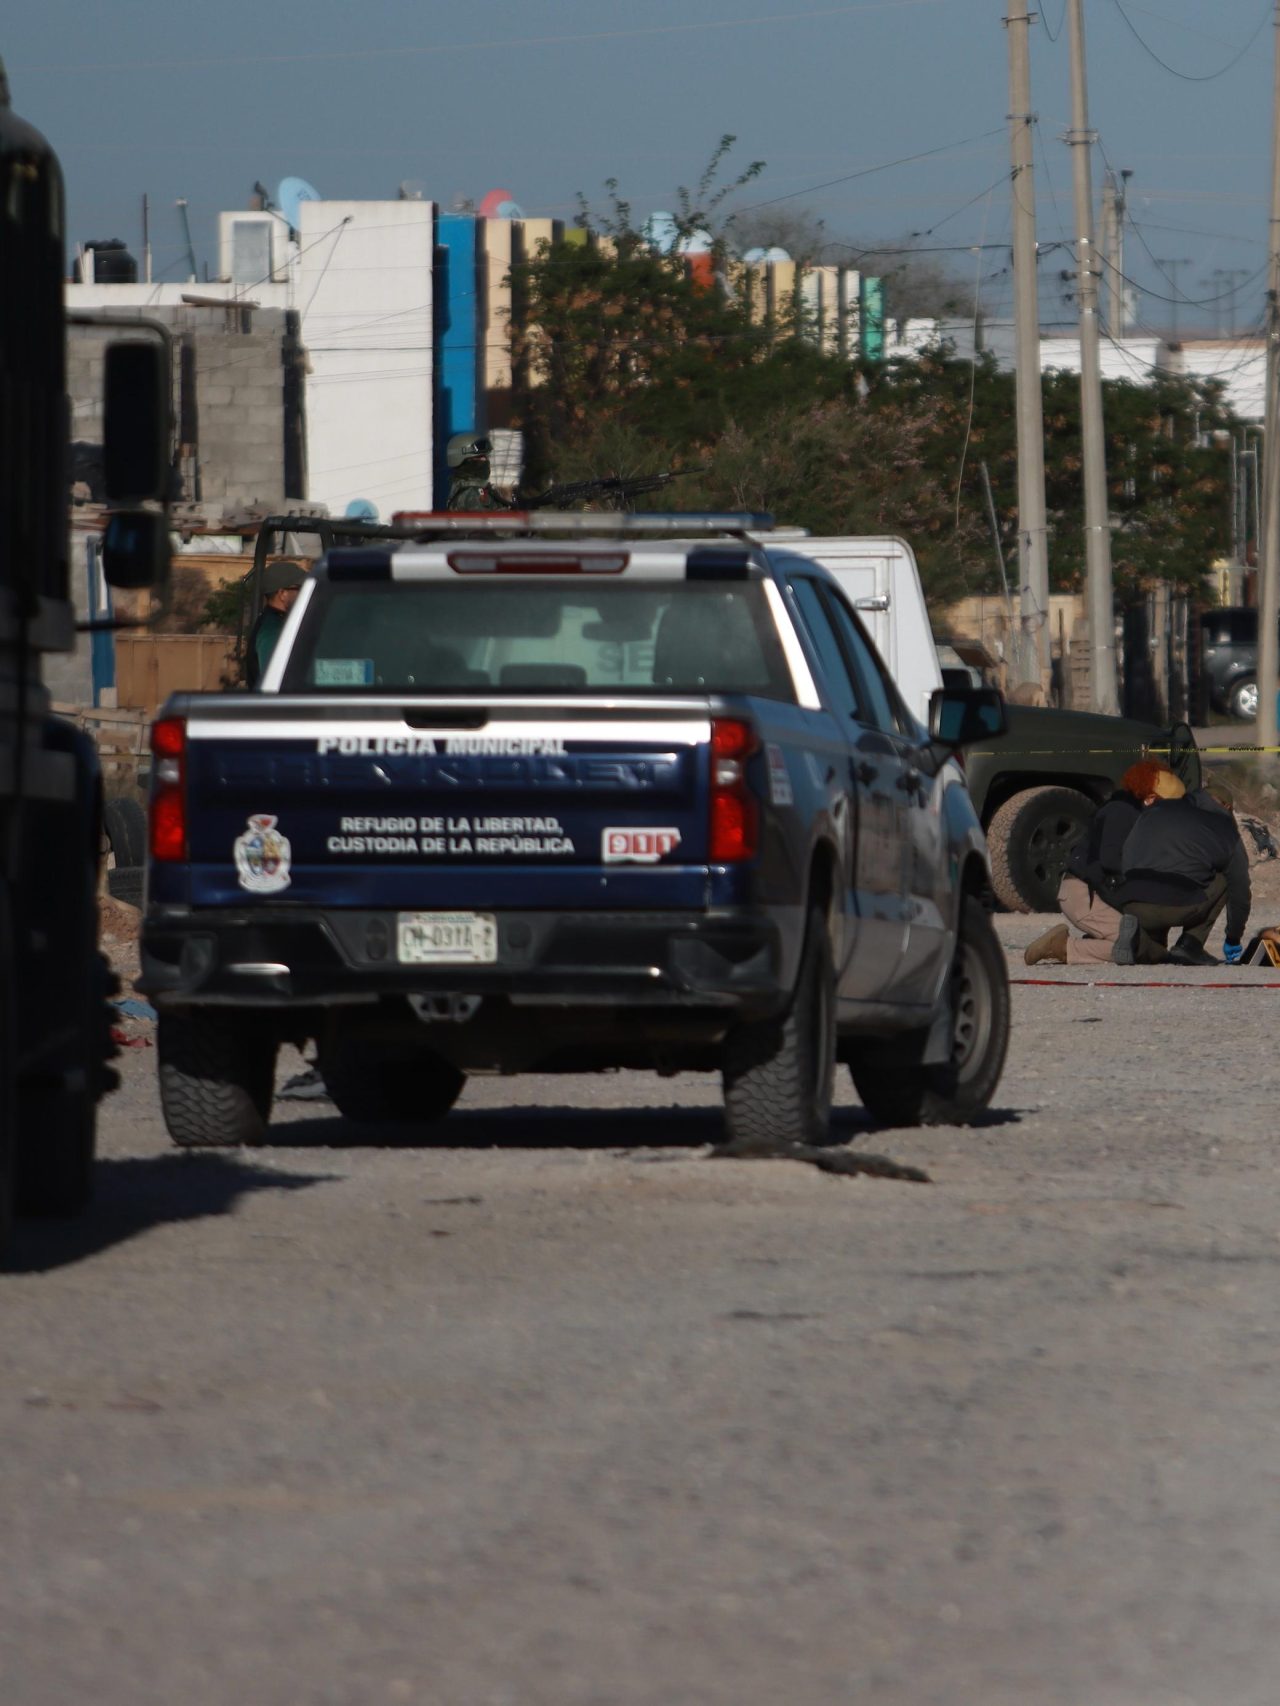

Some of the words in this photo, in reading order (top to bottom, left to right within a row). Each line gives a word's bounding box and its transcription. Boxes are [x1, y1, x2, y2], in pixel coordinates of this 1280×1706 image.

[444, 738, 569, 756] MUNICIPAL
[341, 817, 418, 832] REFUGIO
[420, 817, 445, 832] DE
[449, 817, 471, 832] LA
[473, 817, 563, 835] LIBERTAD,
[328, 836, 419, 853] CUSTODIA
[421, 837, 446, 853] DE
[450, 837, 473, 853] LA
[475, 834, 576, 853] REPÚBLICA
[610, 833, 673, 854] 911
